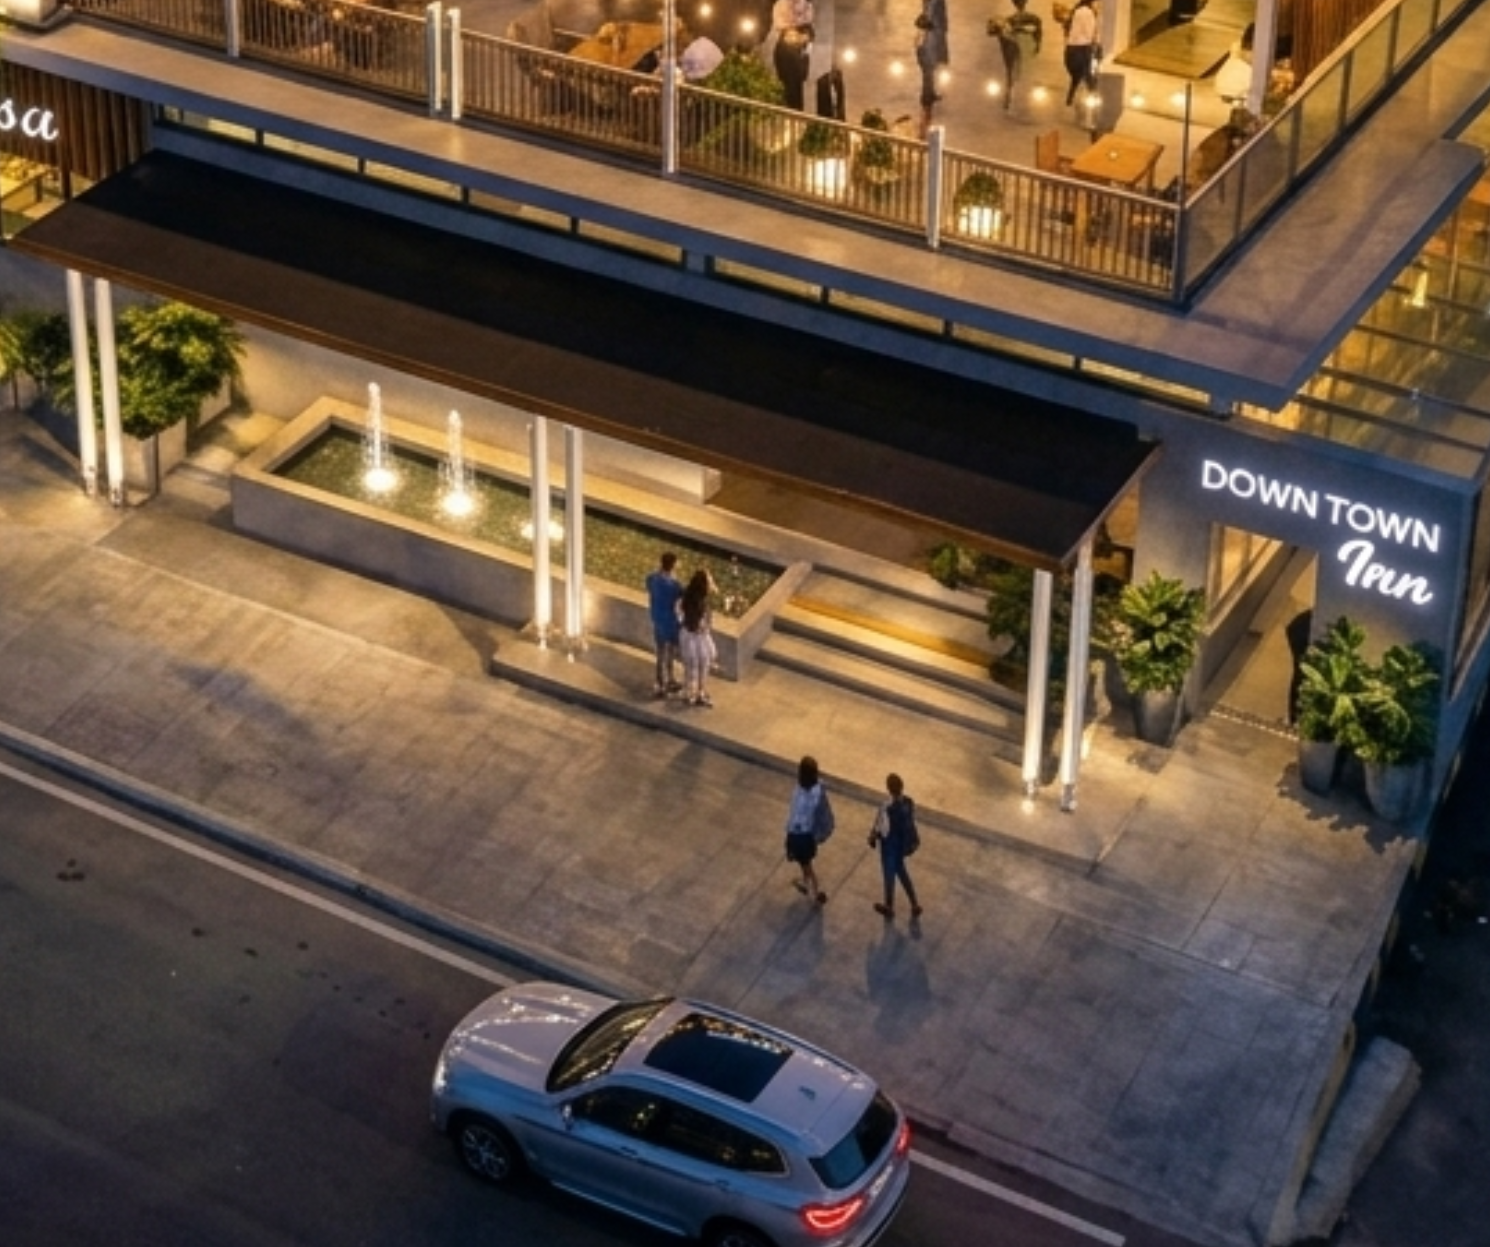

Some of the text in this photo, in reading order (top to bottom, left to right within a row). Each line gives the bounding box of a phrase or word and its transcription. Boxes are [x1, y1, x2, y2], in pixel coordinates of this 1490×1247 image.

[1201, 459, 1441, 553] DOWN TOWN
[1336, 539, 1434, 606] Inn
